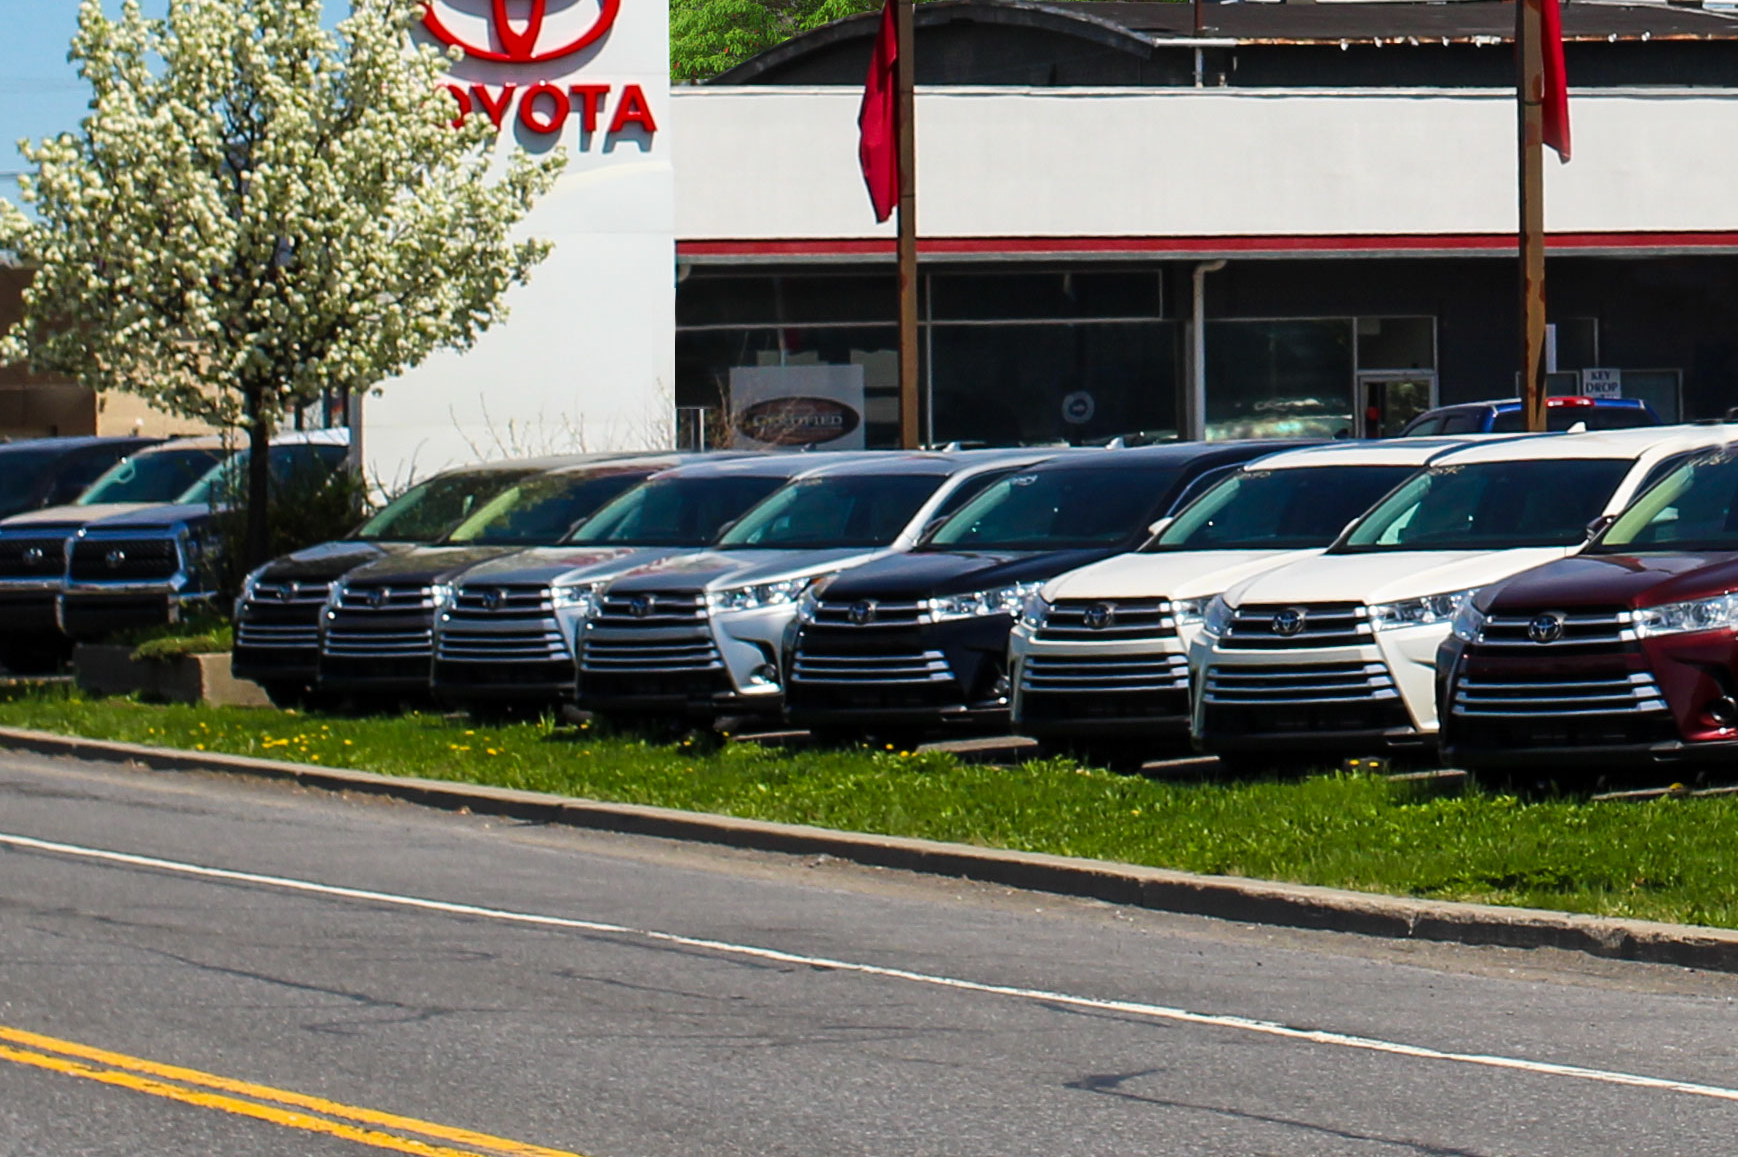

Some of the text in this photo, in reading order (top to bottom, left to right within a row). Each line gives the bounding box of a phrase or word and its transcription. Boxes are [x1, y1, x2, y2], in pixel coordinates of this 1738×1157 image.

[421, 82, 657, 134] OYOTA
[1591, 371, 1609, 380] KEY
[1586, 382, 1618, 392] DROP
